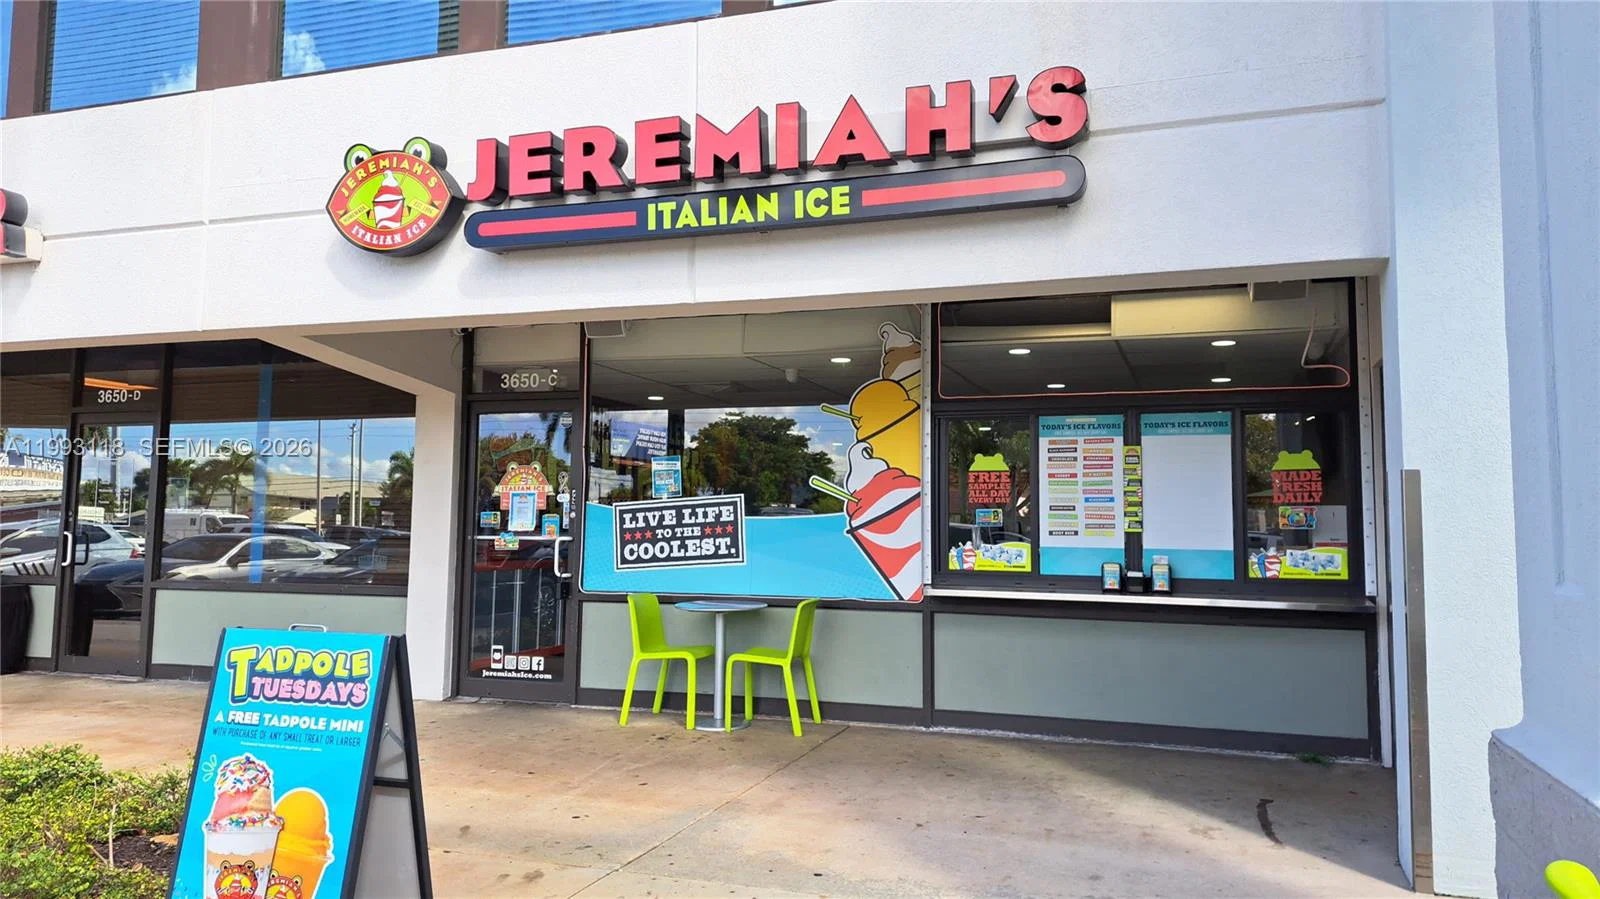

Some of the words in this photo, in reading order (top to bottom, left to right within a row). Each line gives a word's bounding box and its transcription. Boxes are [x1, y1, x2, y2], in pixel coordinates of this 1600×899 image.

[467, 66, 1088, 204] JEREMIAH'S
[341, 156, 438, 197] JEREMIAH'S
[647, 191, 780, 231] ITALIAN
[794, 185, 851, 219] ICE
[352, 225, 402, 245] ITALIAN
[407, 218, 427, 239] ICE
[500, 373, 558, 388] 3650-C
[97, 389, 141, 404] 3650-D
[968, 472, 1010, 483] FREE
[1271, 470, 1322, 481] MADE
[1273, 482, 1322, 491] FRESH
[1273, 492, 1322, 503] DAILY
[623, 509, 676, 529] LIVE
[682, 505, 734, 524] LIFE
[656, 528, 672, 539] TO
[675, 526, 702, 537] THE
[623, 537, 737, 561] COOLEST.
[229, 647, 370, 698] TADPOLE
[251, 676, 368, 705] TUESDAYS
[214, 710, 225, 723] A
[227, 711, 260, 726] FREE
[263, 713, 327, 731] TADPOLE
[329, 718, 365, 733] MINI
[212, 727, 226, 736] WITH
[228, 728, 257, 739] PURCHASE
[260, 730, 266, 739] OF
[270, 731, 281, 740] ANY
[284, 732, 302, 742] SMALL
[304, 734, 323, 743] TREAT
[325, 735, 334, 744] OR
[336, 736, 361, 747] LARGER
